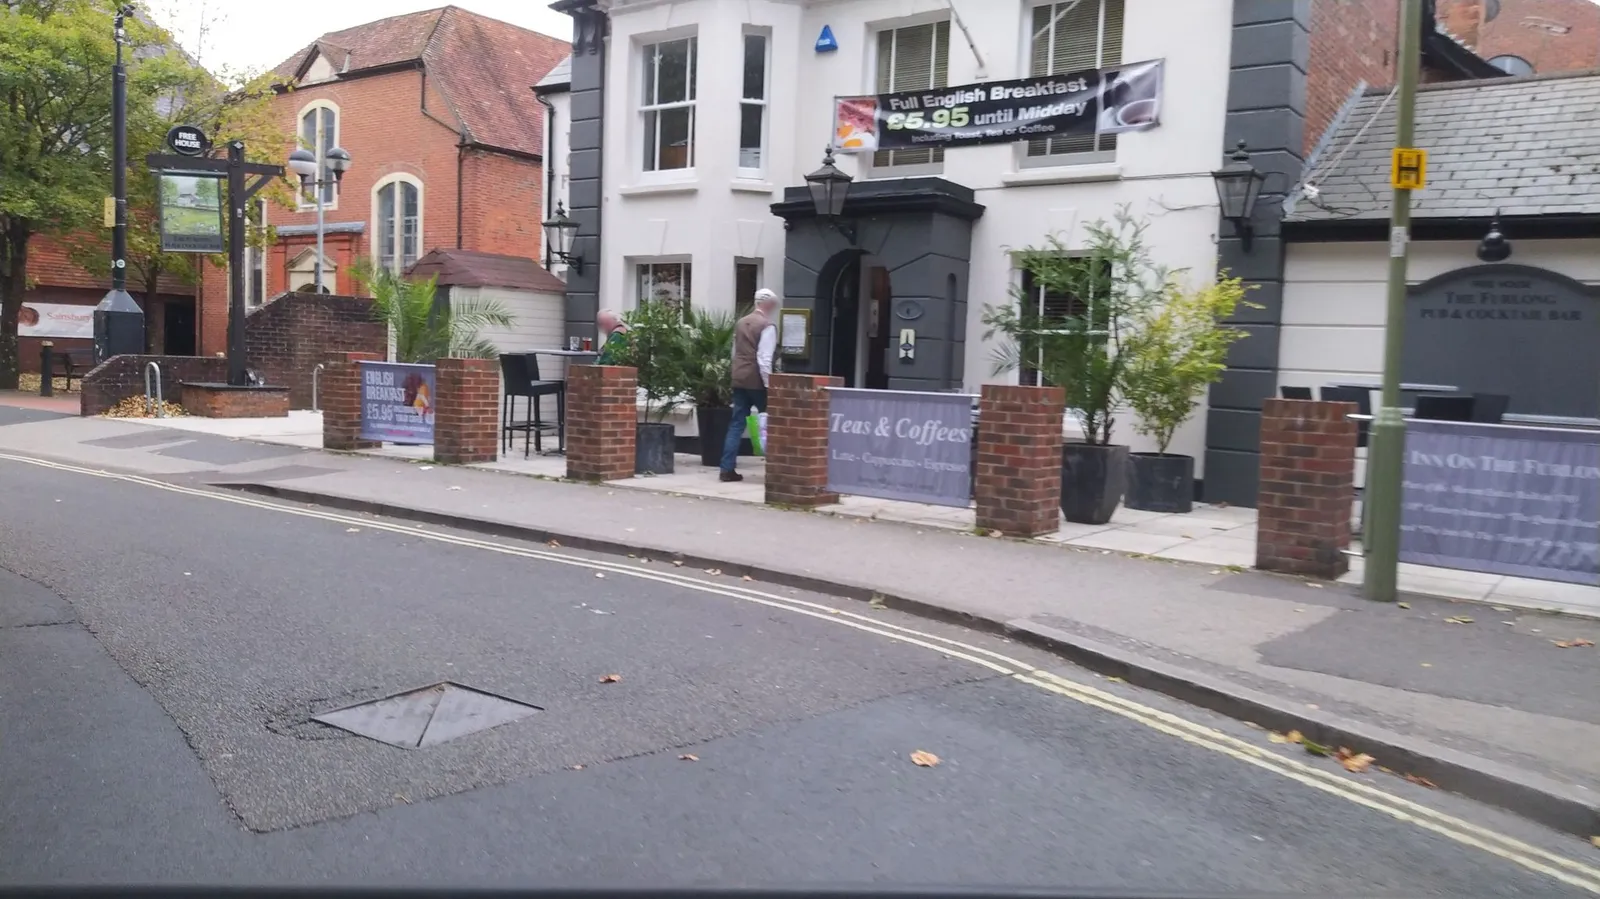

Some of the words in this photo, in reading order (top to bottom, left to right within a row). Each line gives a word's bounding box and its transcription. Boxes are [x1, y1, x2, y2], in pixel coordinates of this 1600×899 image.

[889, 96, 919, 111] Full
[922, 88, 986, 108] English
[990, 77, 1088, 100] Breakfast
[886, 106, 970, 130] £5.95
[974, 108, 1014, 125] until
[1018, 101, 1087, 120] Midday
[178, 132, 197, 140] FREE
[911, 132, 952, 143] Including
[1005, 127, 1017, 135] or
[1019, 124, 1056, 134] Coffee
[175, 139, 200, 148] HOUSE
[1420, 308, 1449, 320] PUB
[1465, 308, 1542, 320] COCKTAIL
[1549, 309, 1582, 321] BAR
[366, 371, 394, 386] ENGLISH
[366, 385, 406, 402] BREAKFAST
[366, 403, 394, 421] £5.95
[831, 413, 872, 436] Teas
[874, 416, 891, 437] &
[895, 417, 969, 446] Coffees
